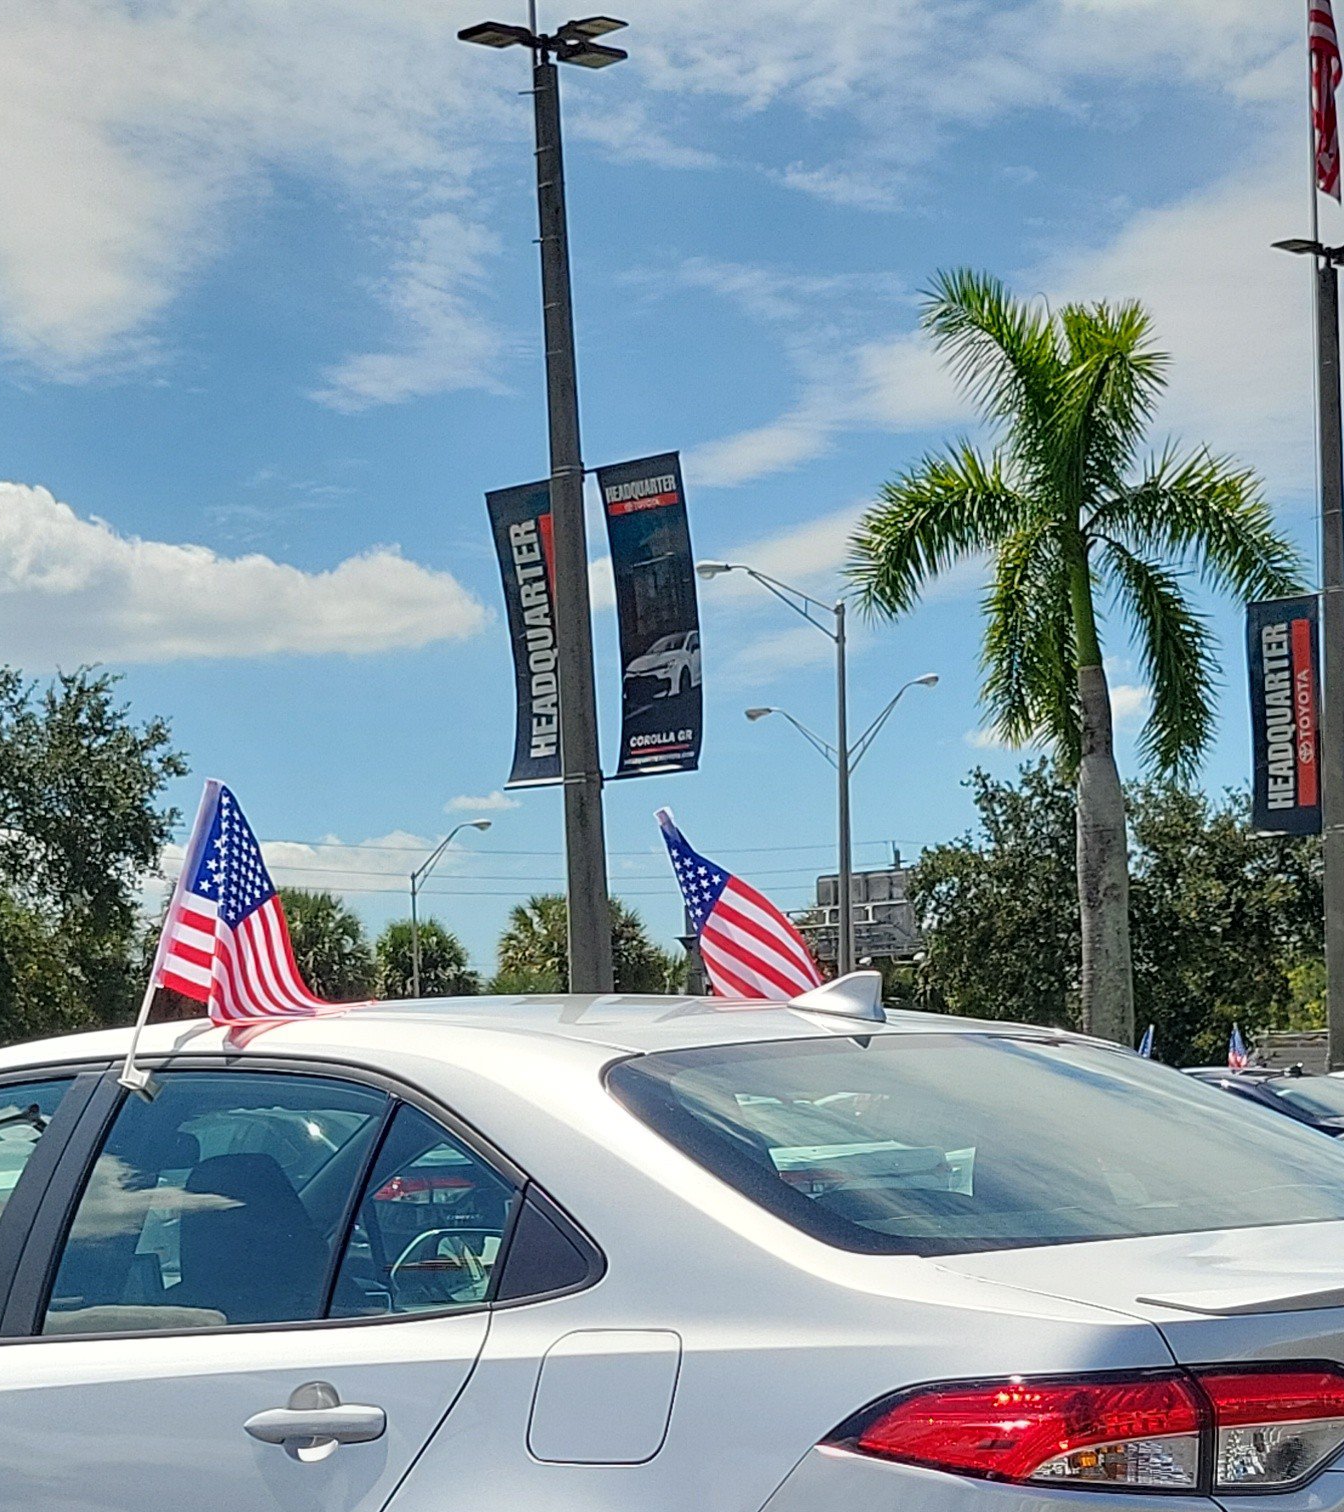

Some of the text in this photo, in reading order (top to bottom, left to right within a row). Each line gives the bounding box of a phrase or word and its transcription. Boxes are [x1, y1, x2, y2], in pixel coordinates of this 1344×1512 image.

[605, 474, 677, 504] HEADQUARTER
[509, 518, 559, 758] HEADQUARTER
[629, 729, 693, 748] COROLLA GR
[1262, 622, 1296, 809] HEADQUARTER
[1297, 669, 1313, 740] TOYOTA
